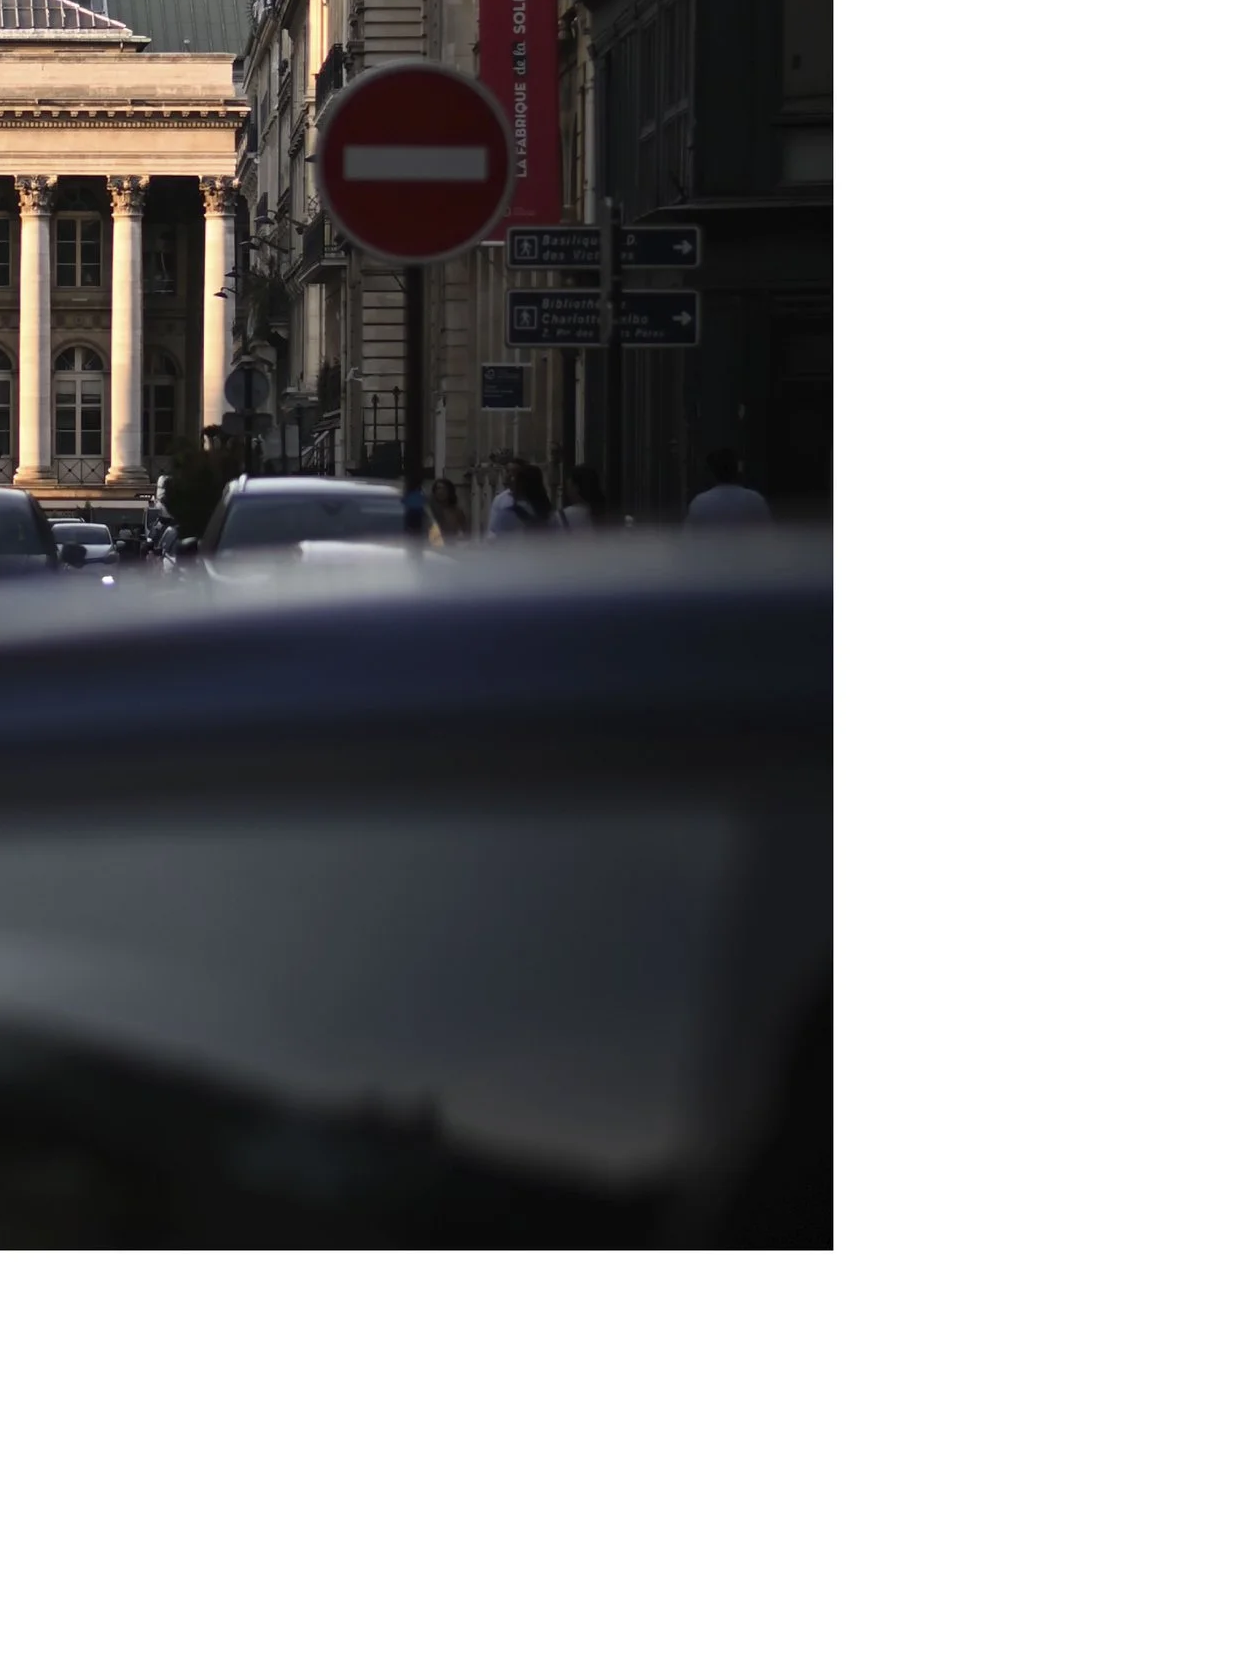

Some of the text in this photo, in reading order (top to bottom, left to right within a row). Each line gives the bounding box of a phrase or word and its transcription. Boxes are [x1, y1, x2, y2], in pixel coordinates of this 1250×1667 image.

[511, 40, 527, 56] la
[511, 59, 527, 75] de
[514, 82, 528, 154] FABRIQUE
[515, 159, 528, 178] LA
[541, 234, 600, 247] Basiliqu
[542, 249, 565, 261] des
